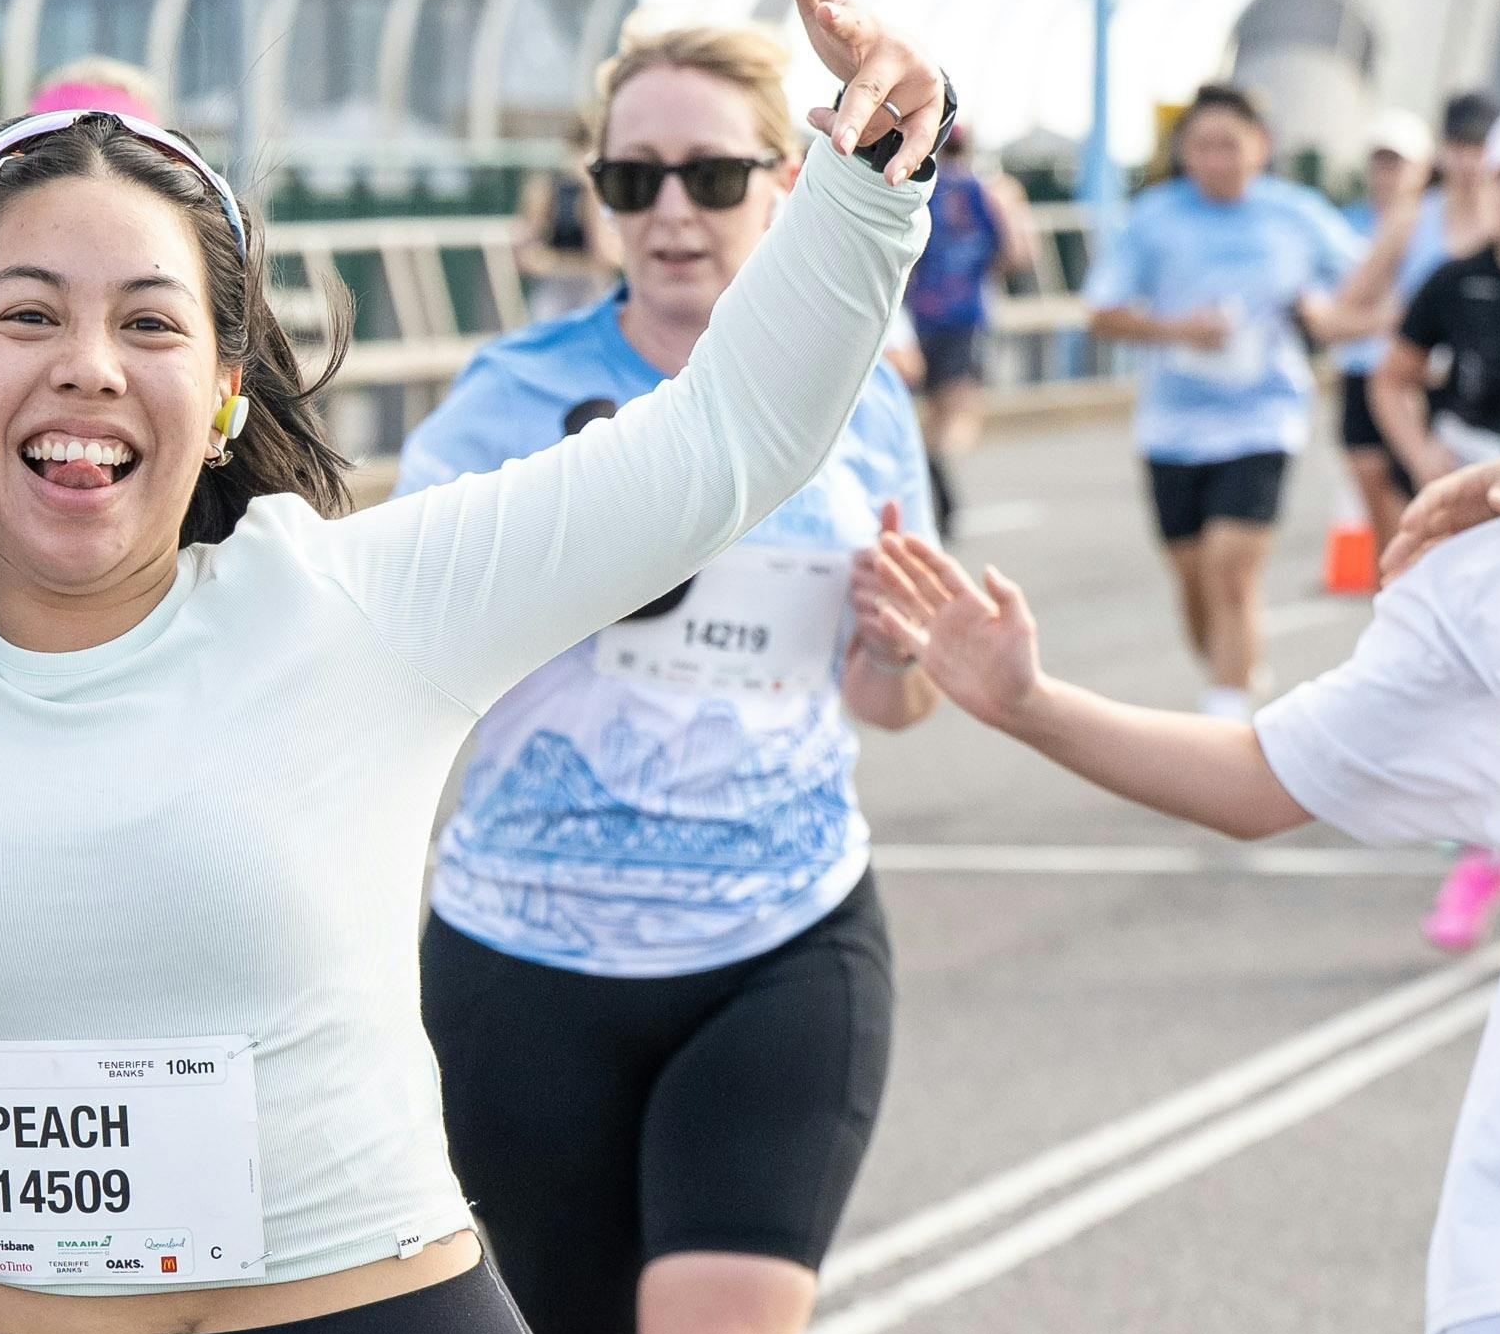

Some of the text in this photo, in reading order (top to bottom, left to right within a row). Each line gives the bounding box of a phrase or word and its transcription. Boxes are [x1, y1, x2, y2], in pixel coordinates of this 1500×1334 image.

[97, 1059, 215, 1075] TENERIFFE 10km
[109, 1069, 144, 1078] BANKS
[210, 1246, 222, 1259] C
